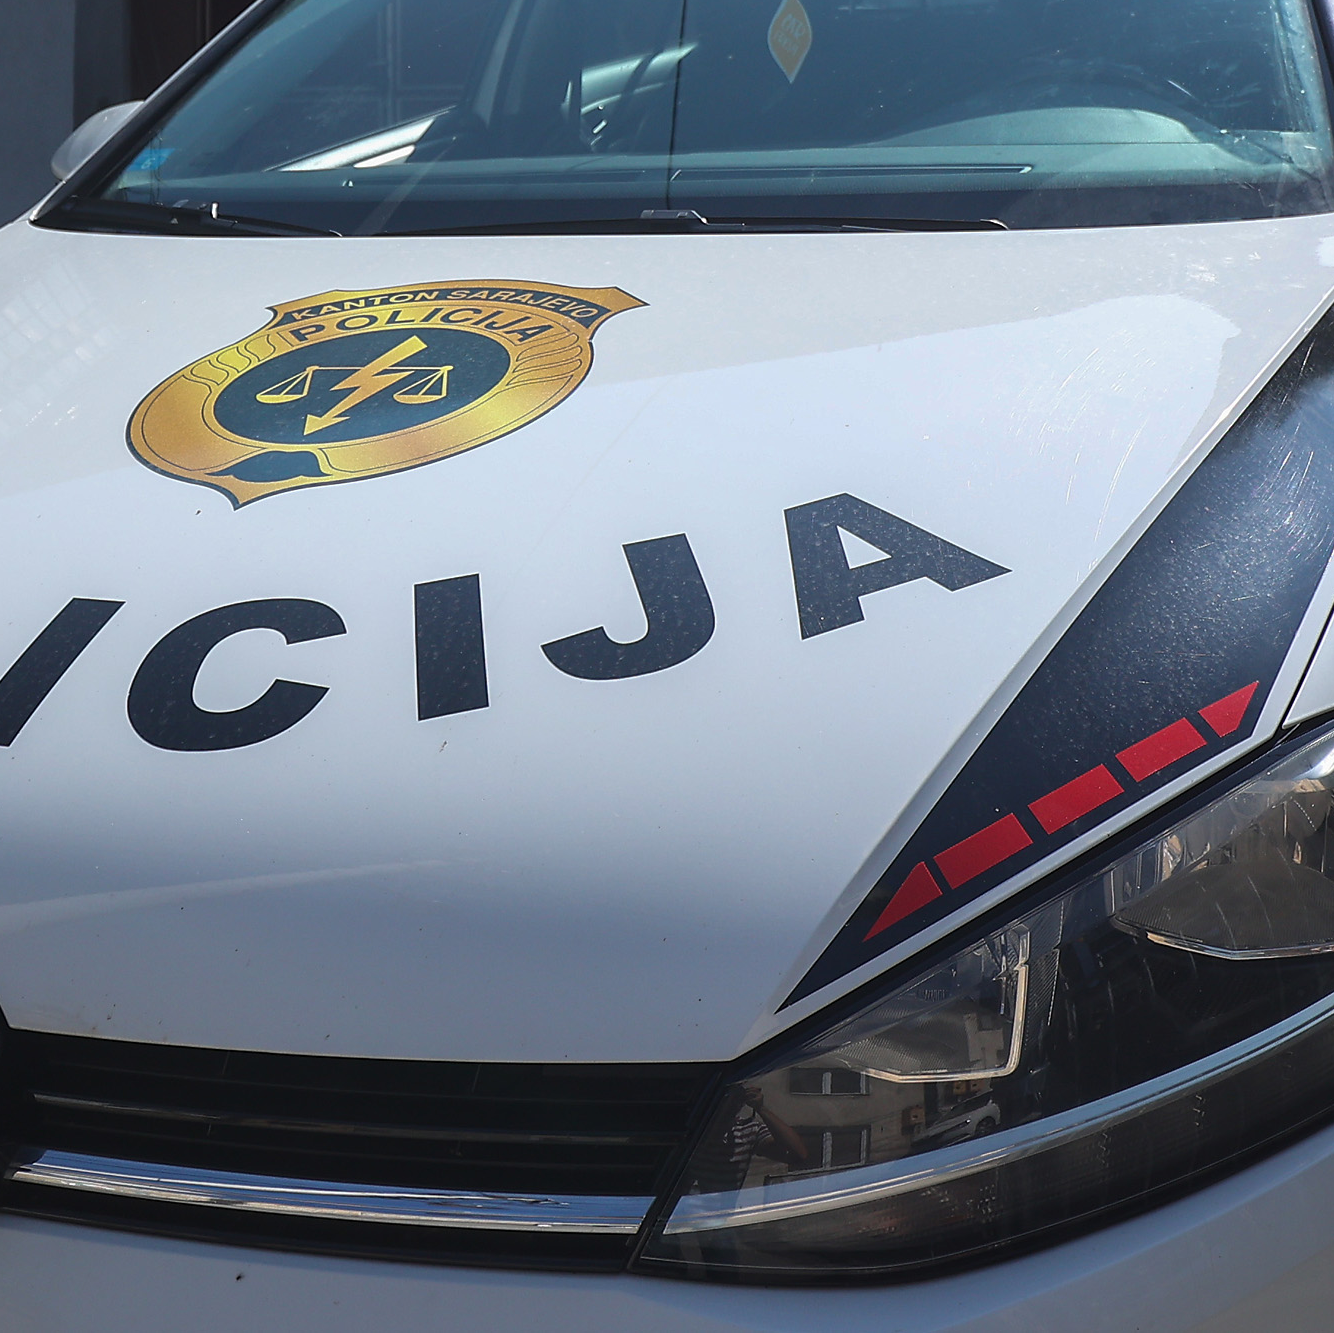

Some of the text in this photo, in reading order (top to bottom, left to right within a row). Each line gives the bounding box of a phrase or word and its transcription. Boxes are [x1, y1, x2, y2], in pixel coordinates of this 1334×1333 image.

[291, 290, 599, 320] KANTON SARAJEVO
[289, 307, 554, 343] POLICIJA
